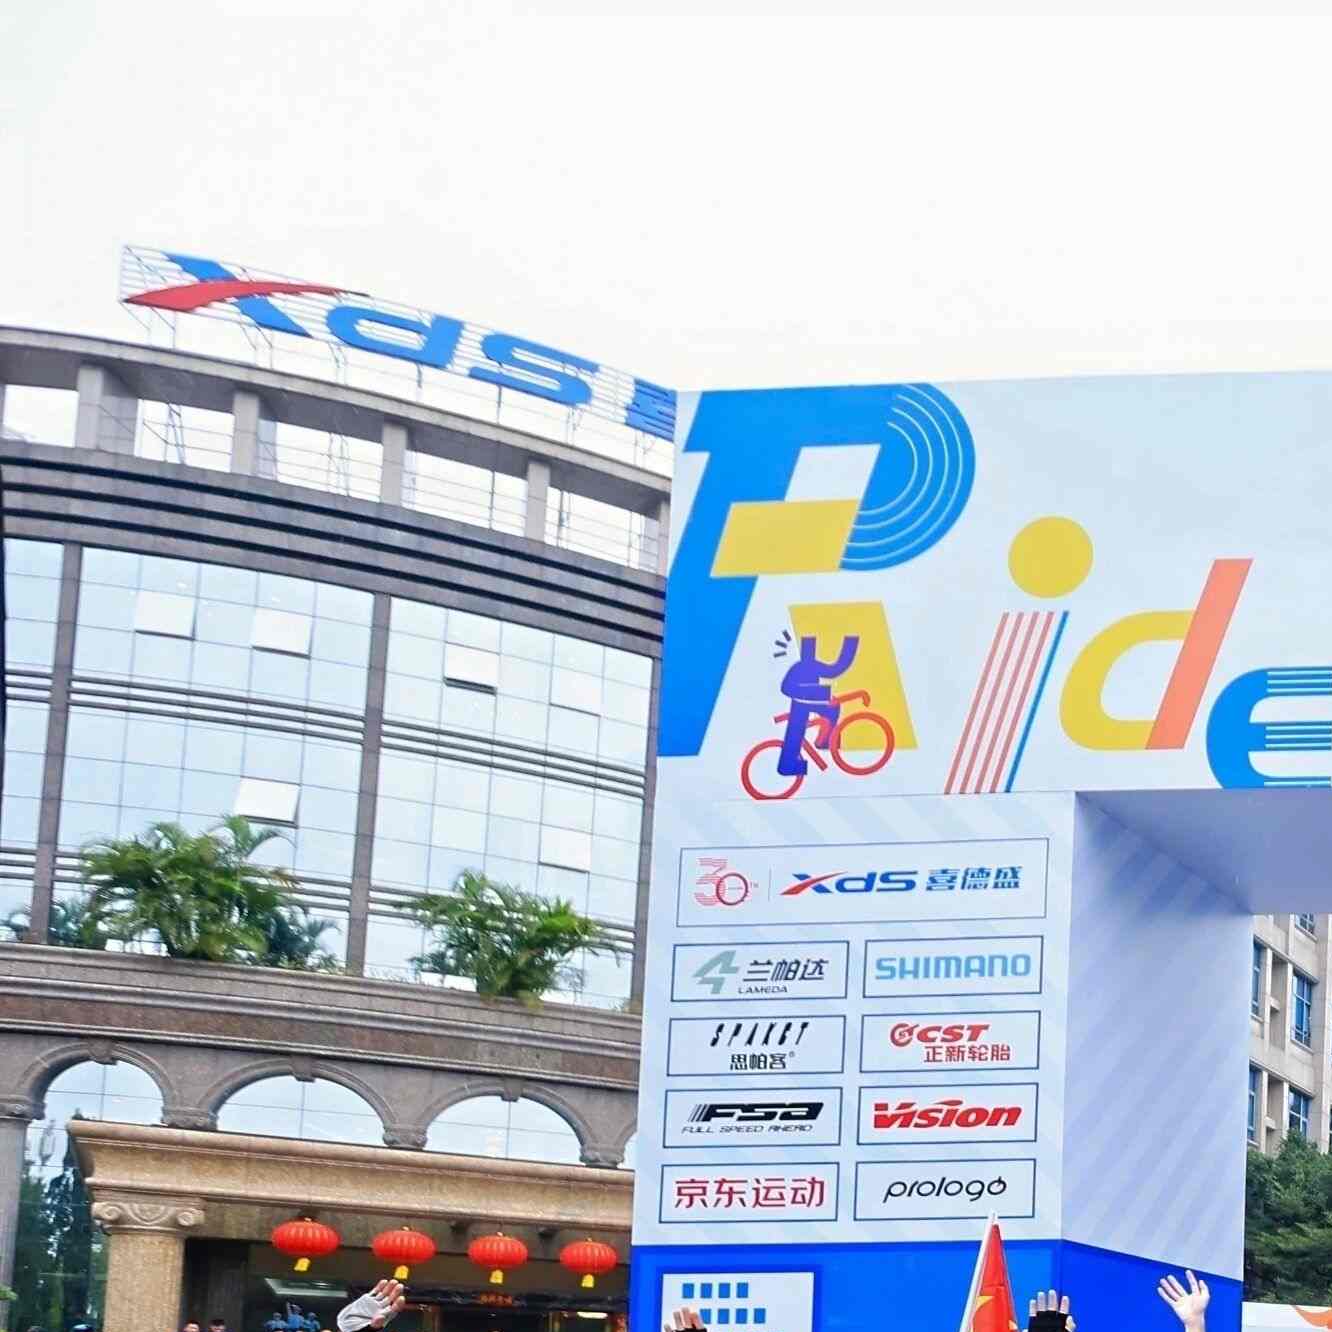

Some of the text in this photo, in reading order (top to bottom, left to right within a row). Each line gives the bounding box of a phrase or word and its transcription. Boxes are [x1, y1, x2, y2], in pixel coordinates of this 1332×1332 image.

[925, 866, 1022, 891] 喜德盛
[742, 958, 829, 982] 兰帕达
[875, 952, 1031, 980] SHIMANO
[917, 1024, 990, 1043] CST
[924, 1044, 1011, 1063] 正新轮胎
[675, 1177, 825, 1209] 京东运动
[883, 1177, 1007, 1204] prologo
